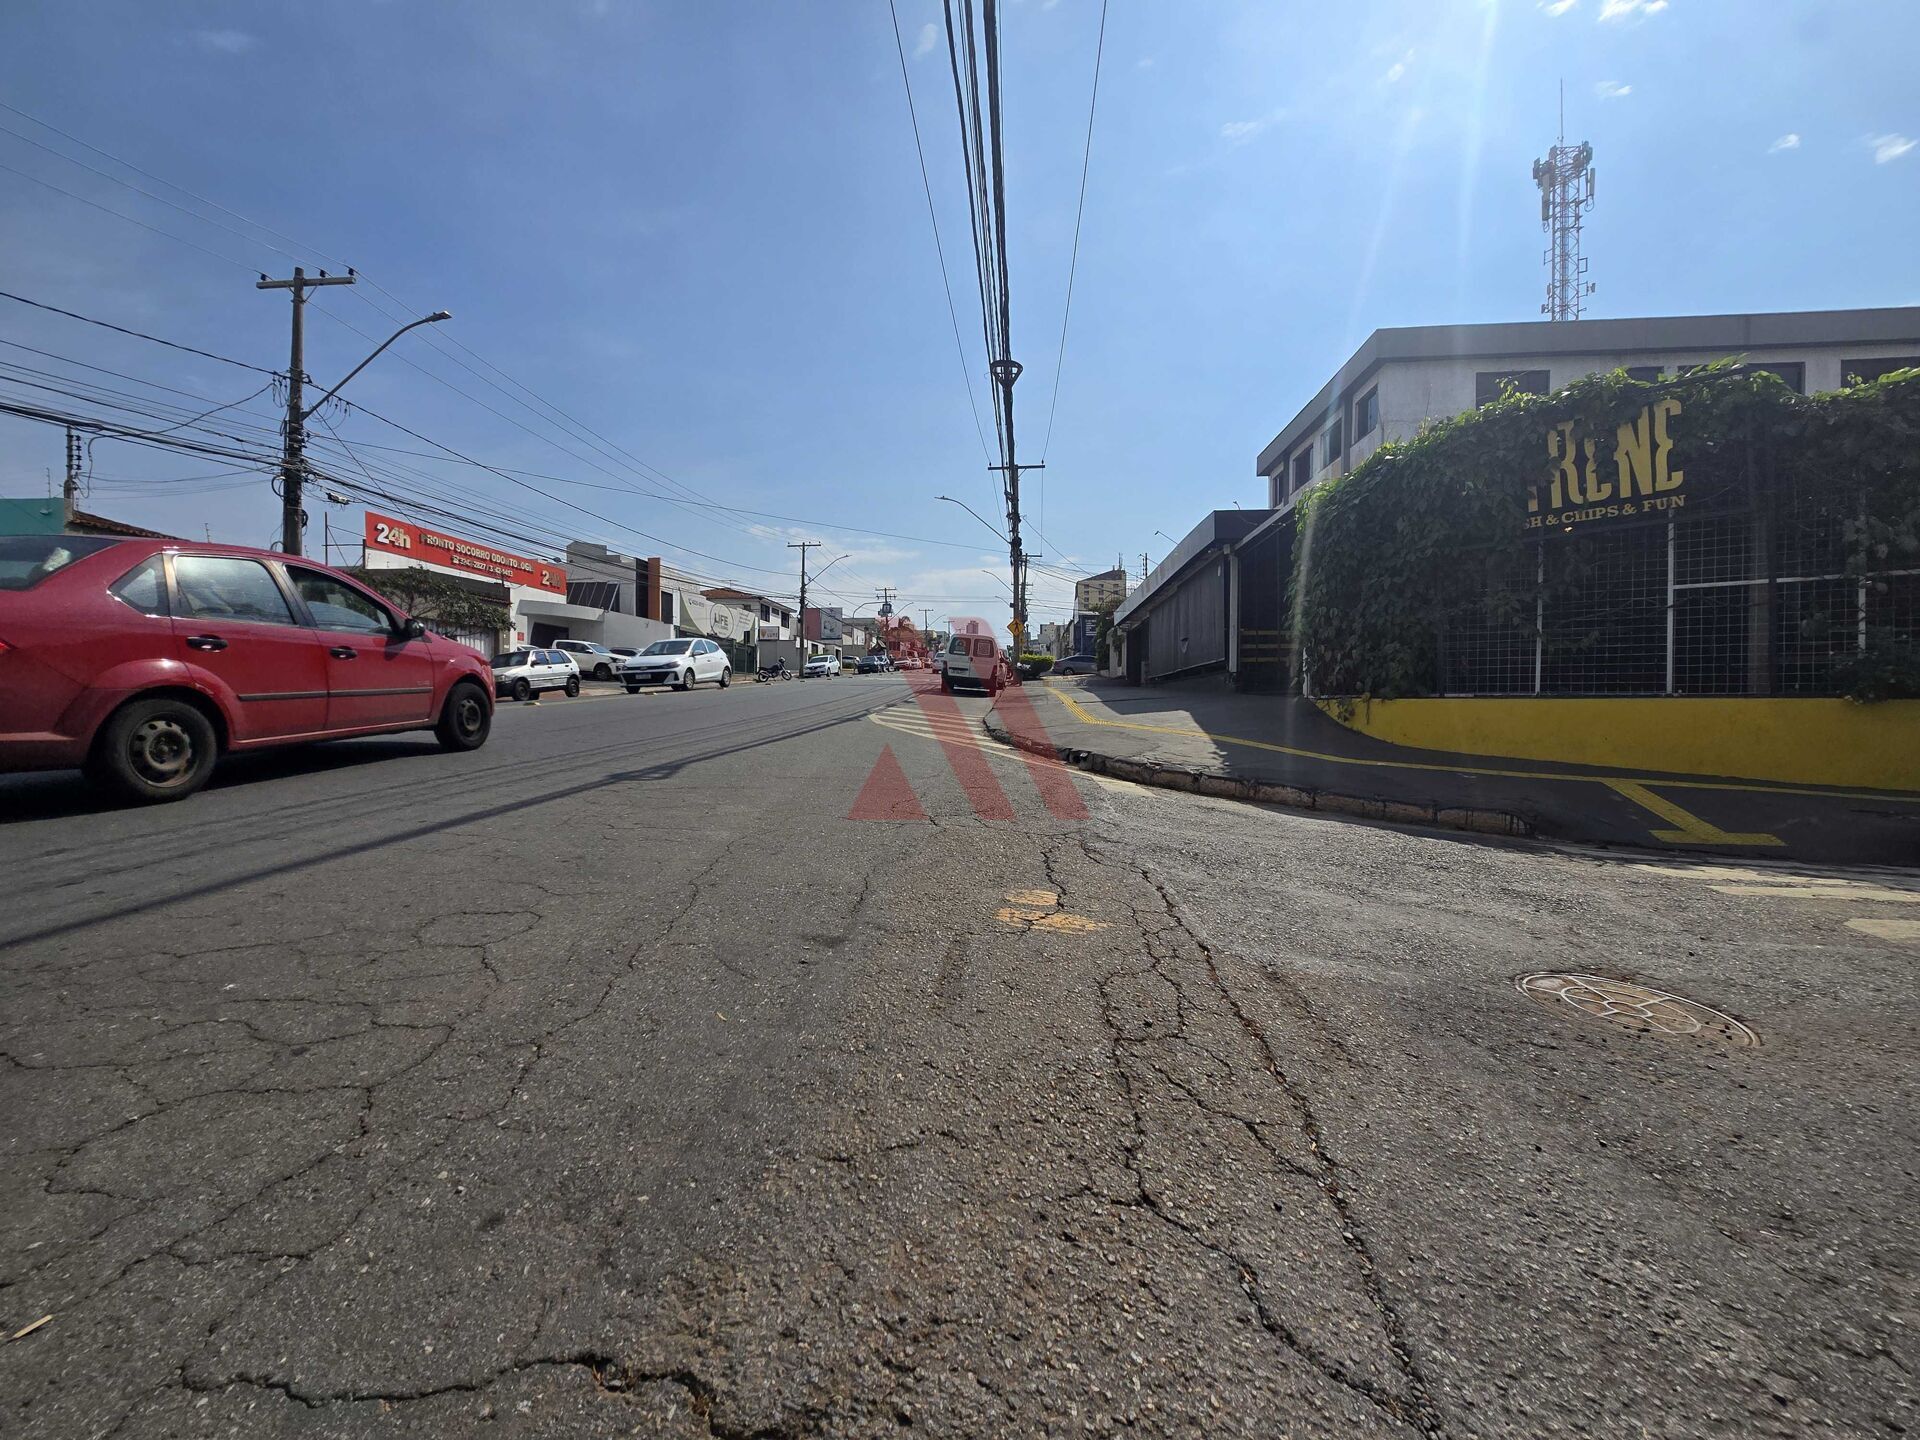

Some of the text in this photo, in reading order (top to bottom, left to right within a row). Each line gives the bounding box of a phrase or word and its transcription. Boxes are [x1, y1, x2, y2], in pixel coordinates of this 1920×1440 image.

[1546, 515, 1559, 526] &
[1561, 505, 1618, 523] CHIPS
[1622, 503, 1637, 515] &
[1642, 495, 1686, 512] FUN
[376, 523, 411, 549] 24h
[455, 543, 490, 560] SOCORRO
[714, 612, 728, 626] LIFE
